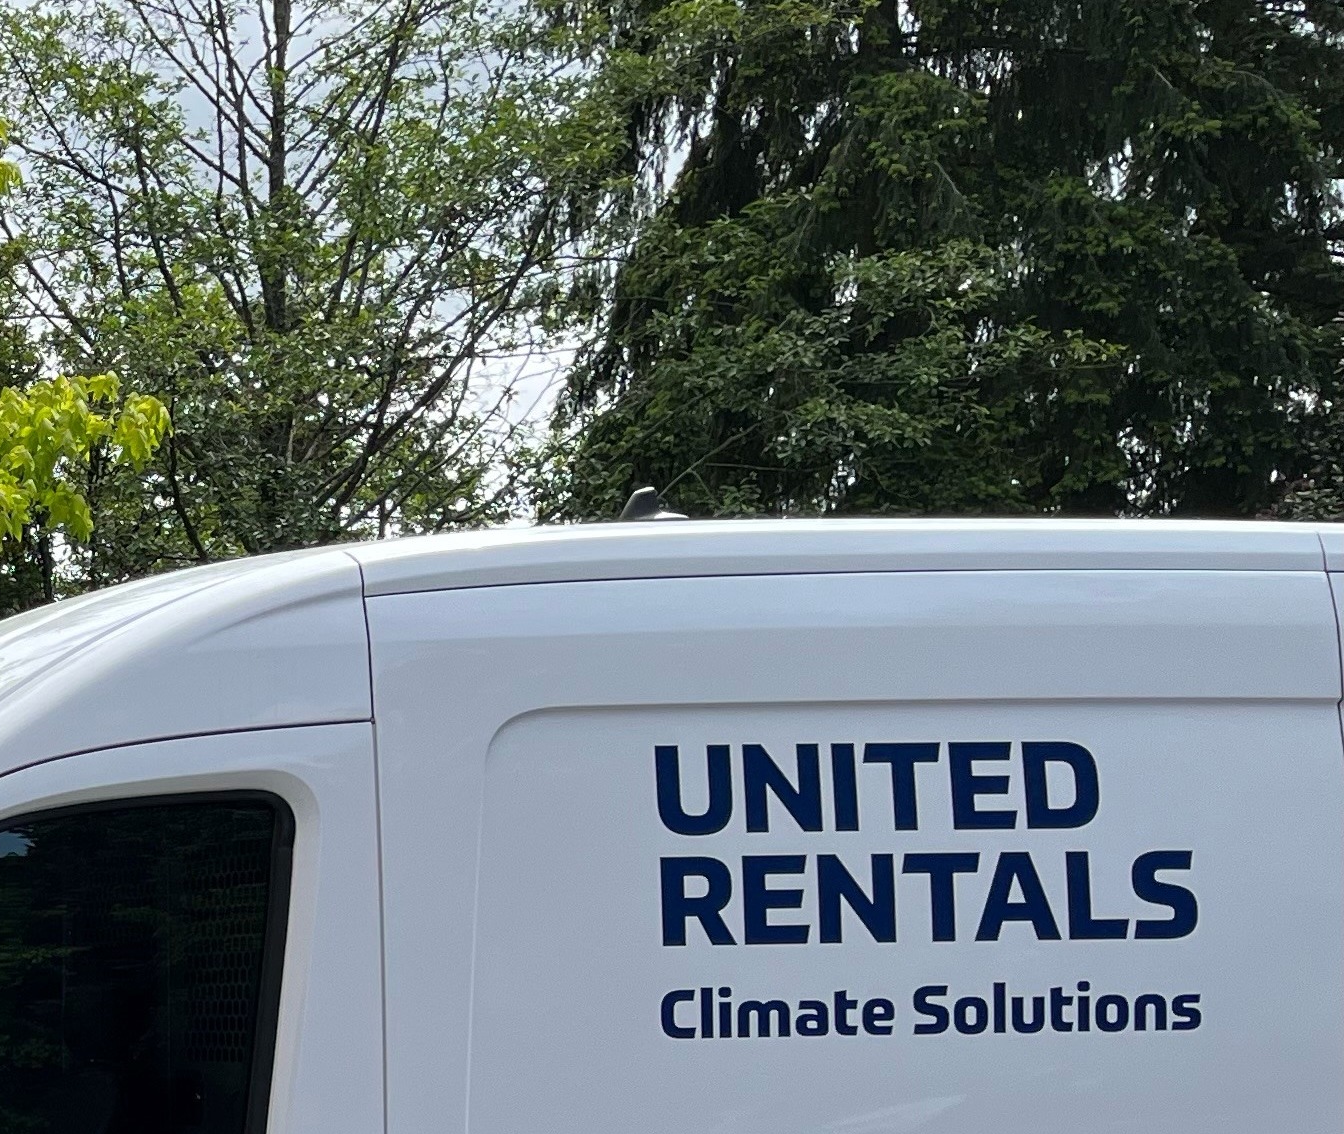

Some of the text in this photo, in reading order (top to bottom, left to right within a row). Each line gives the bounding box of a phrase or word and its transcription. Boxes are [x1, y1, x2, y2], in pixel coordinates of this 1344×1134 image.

[654, 741, 1100, 836] UNITED
[659, 849, 1199, 946] RENTALS
[660, 980, 1202, 1040] Climate Solutions
